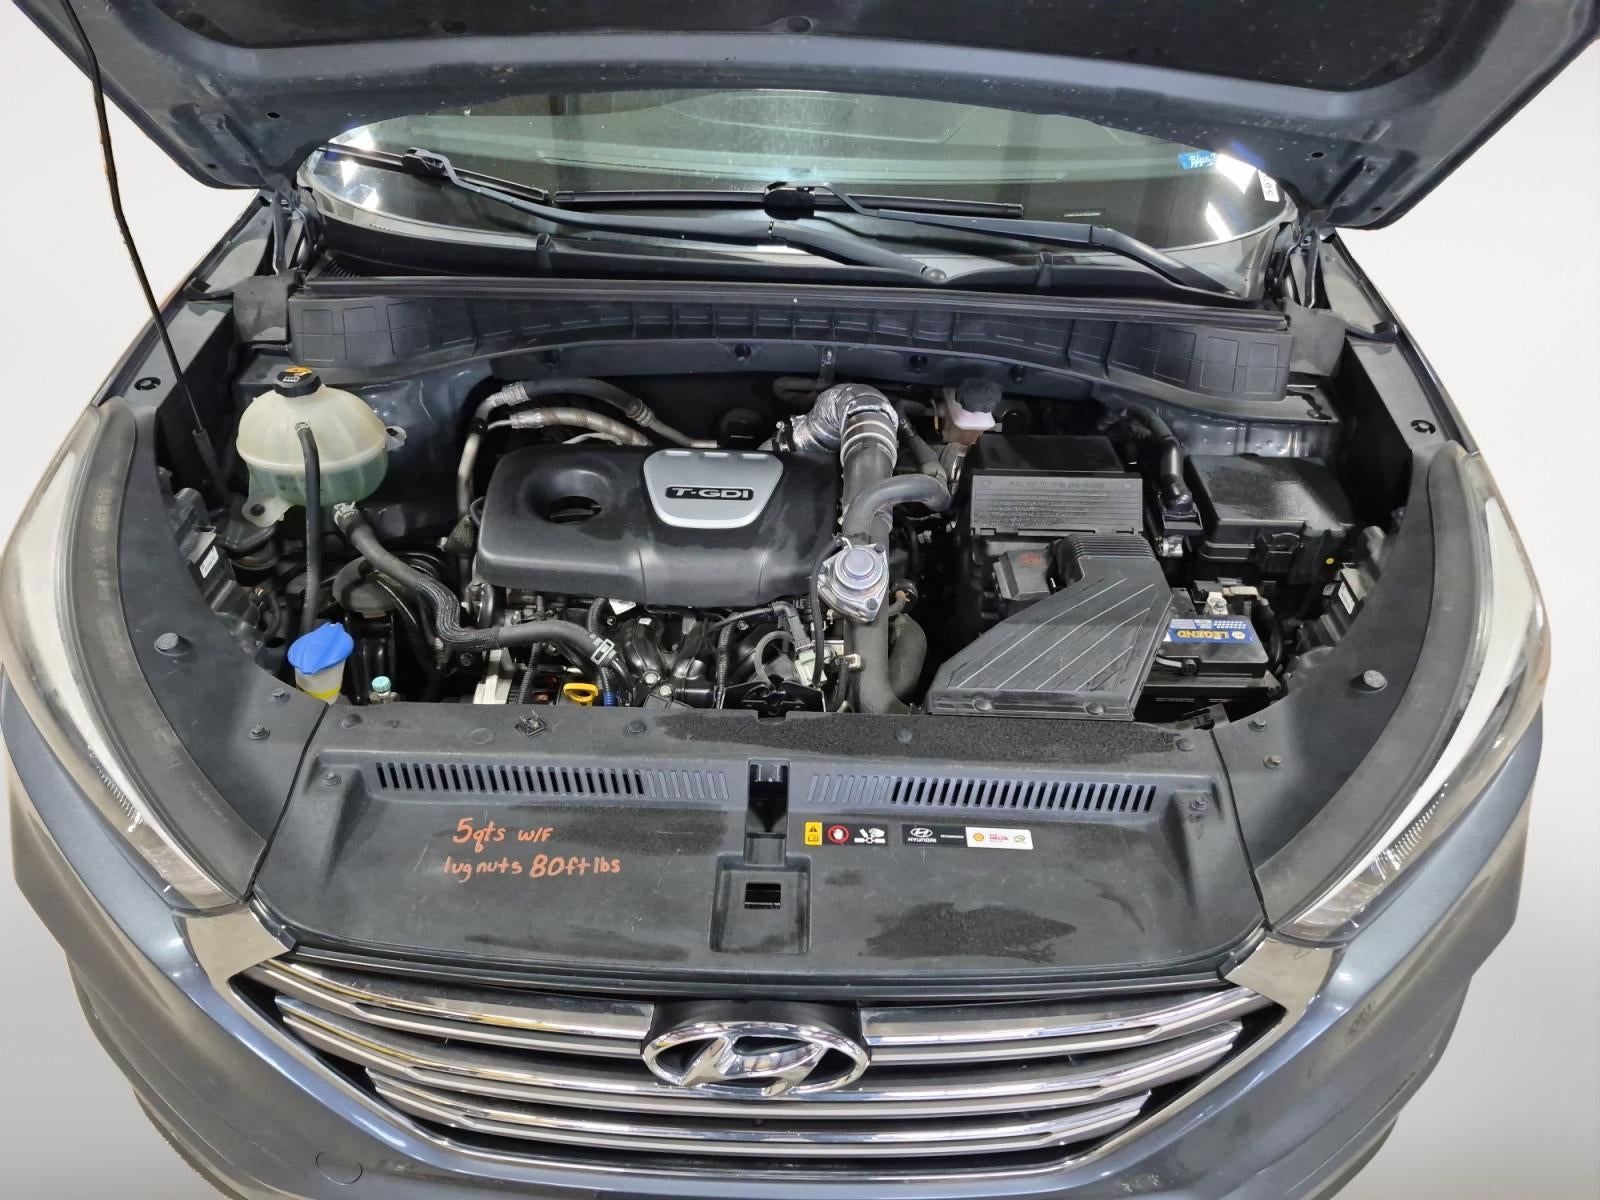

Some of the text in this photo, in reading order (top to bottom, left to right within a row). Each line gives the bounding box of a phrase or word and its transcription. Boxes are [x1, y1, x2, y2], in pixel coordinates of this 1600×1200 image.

[671, 488, 749, 498] T-GDI
[907, 836, 937, 844] HYUNDAI
[475, 857, 523, 874] nuts
